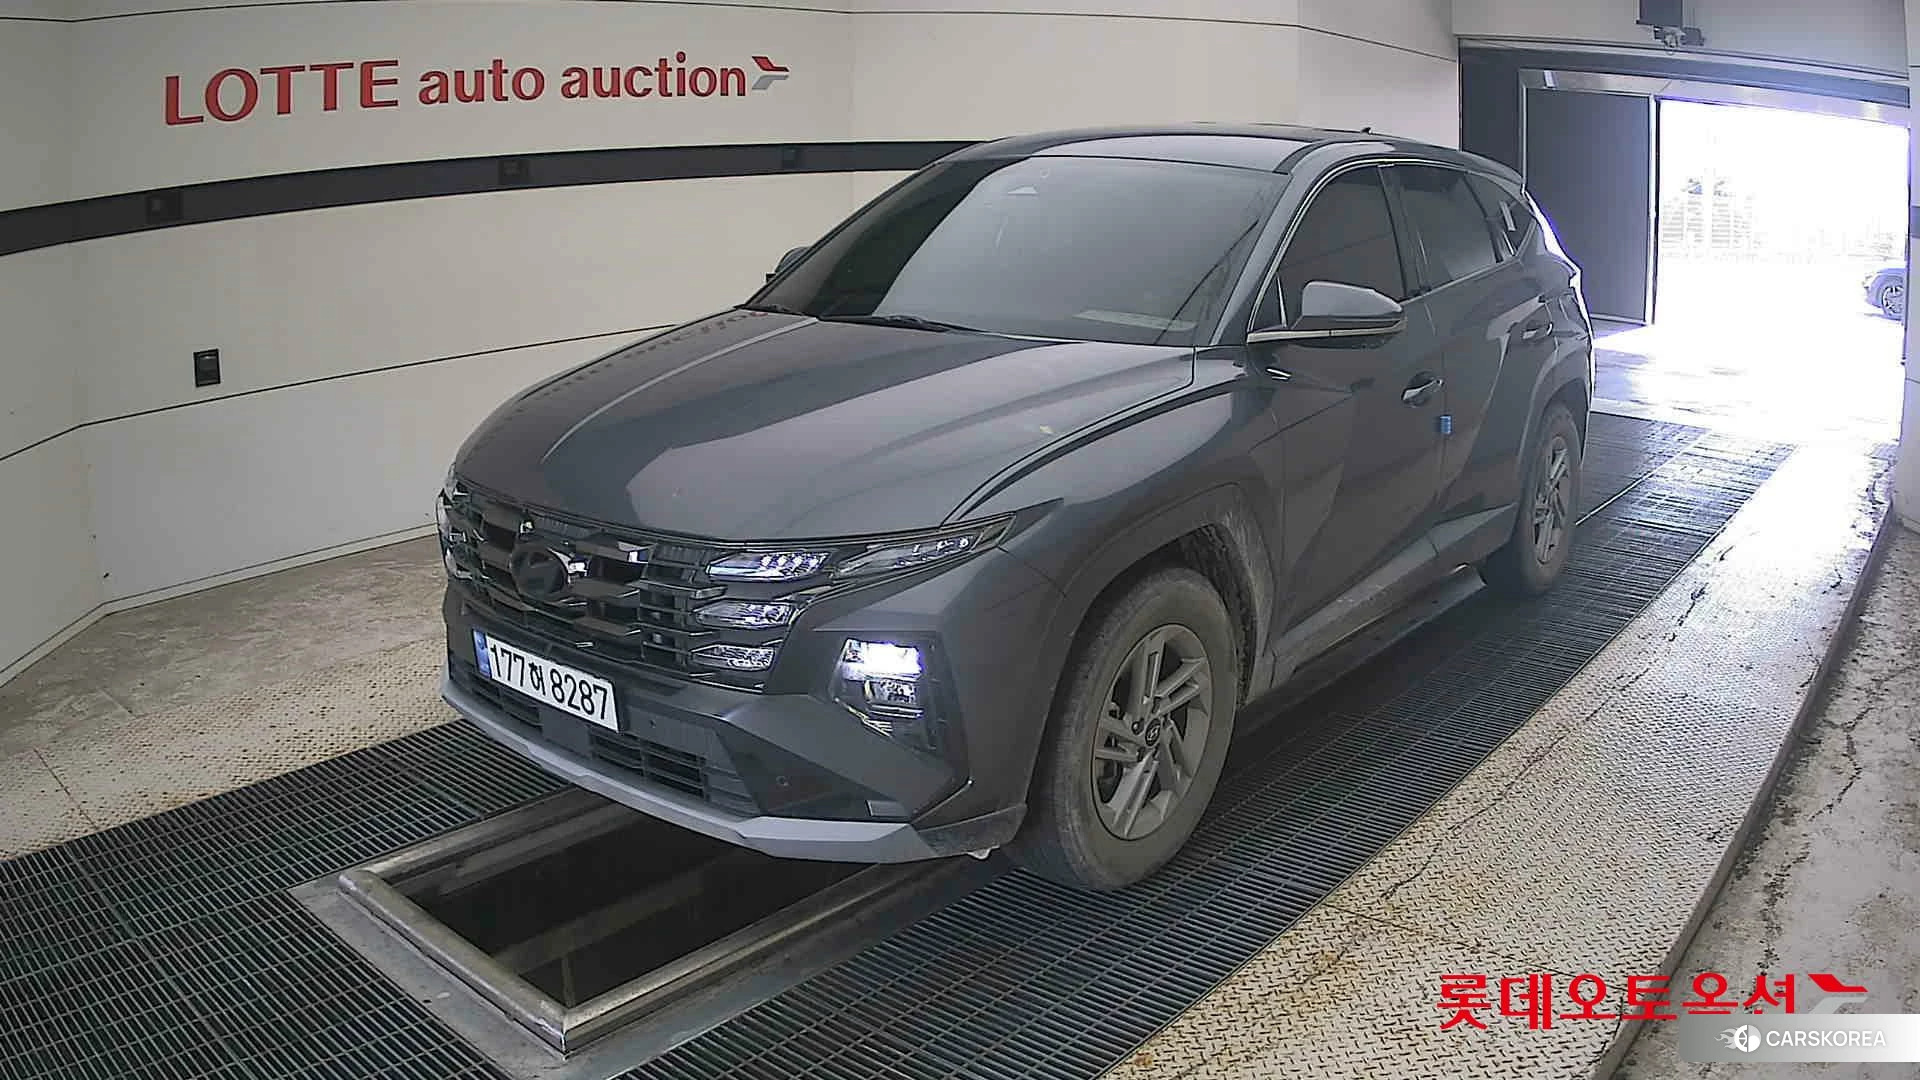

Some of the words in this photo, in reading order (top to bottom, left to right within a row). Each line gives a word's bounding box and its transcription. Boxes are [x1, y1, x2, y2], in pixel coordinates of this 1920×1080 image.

[165, 59, 400, 126] LOTTE
[418, 58, 545, 105] auto
[560, 51, 748, 98] auction
